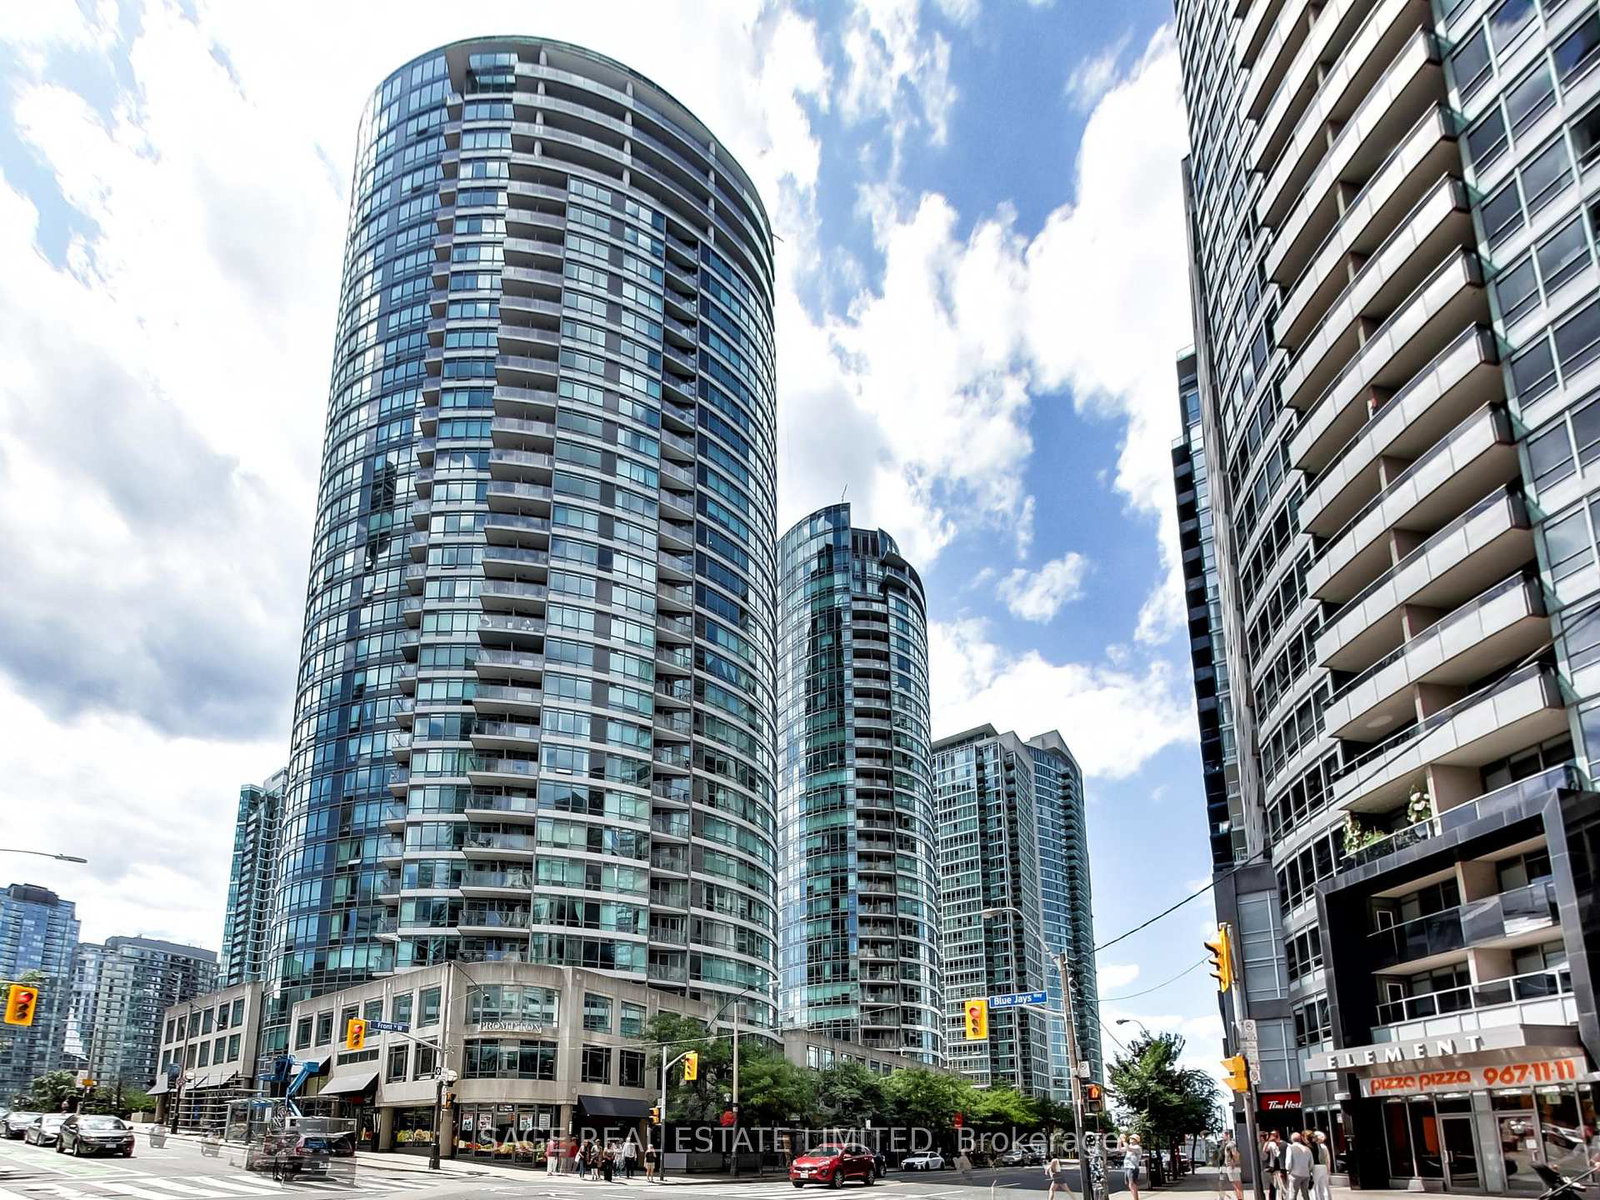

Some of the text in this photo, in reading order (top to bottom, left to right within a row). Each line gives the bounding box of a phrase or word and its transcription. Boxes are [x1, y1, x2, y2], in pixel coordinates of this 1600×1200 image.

[994, 996, 1012, 1006] Blue
[1014, 994, 1032, 1005] Jays
[377, 1022, 393, 1030] Front
[1327, 1035, 1480, 1070] ELEMENT
[1370, 1075, 1416, 1095] pizza
[1419, 1070, 1472, 1092] pizza
[1267, 1100, 1284, 1110] Tim
